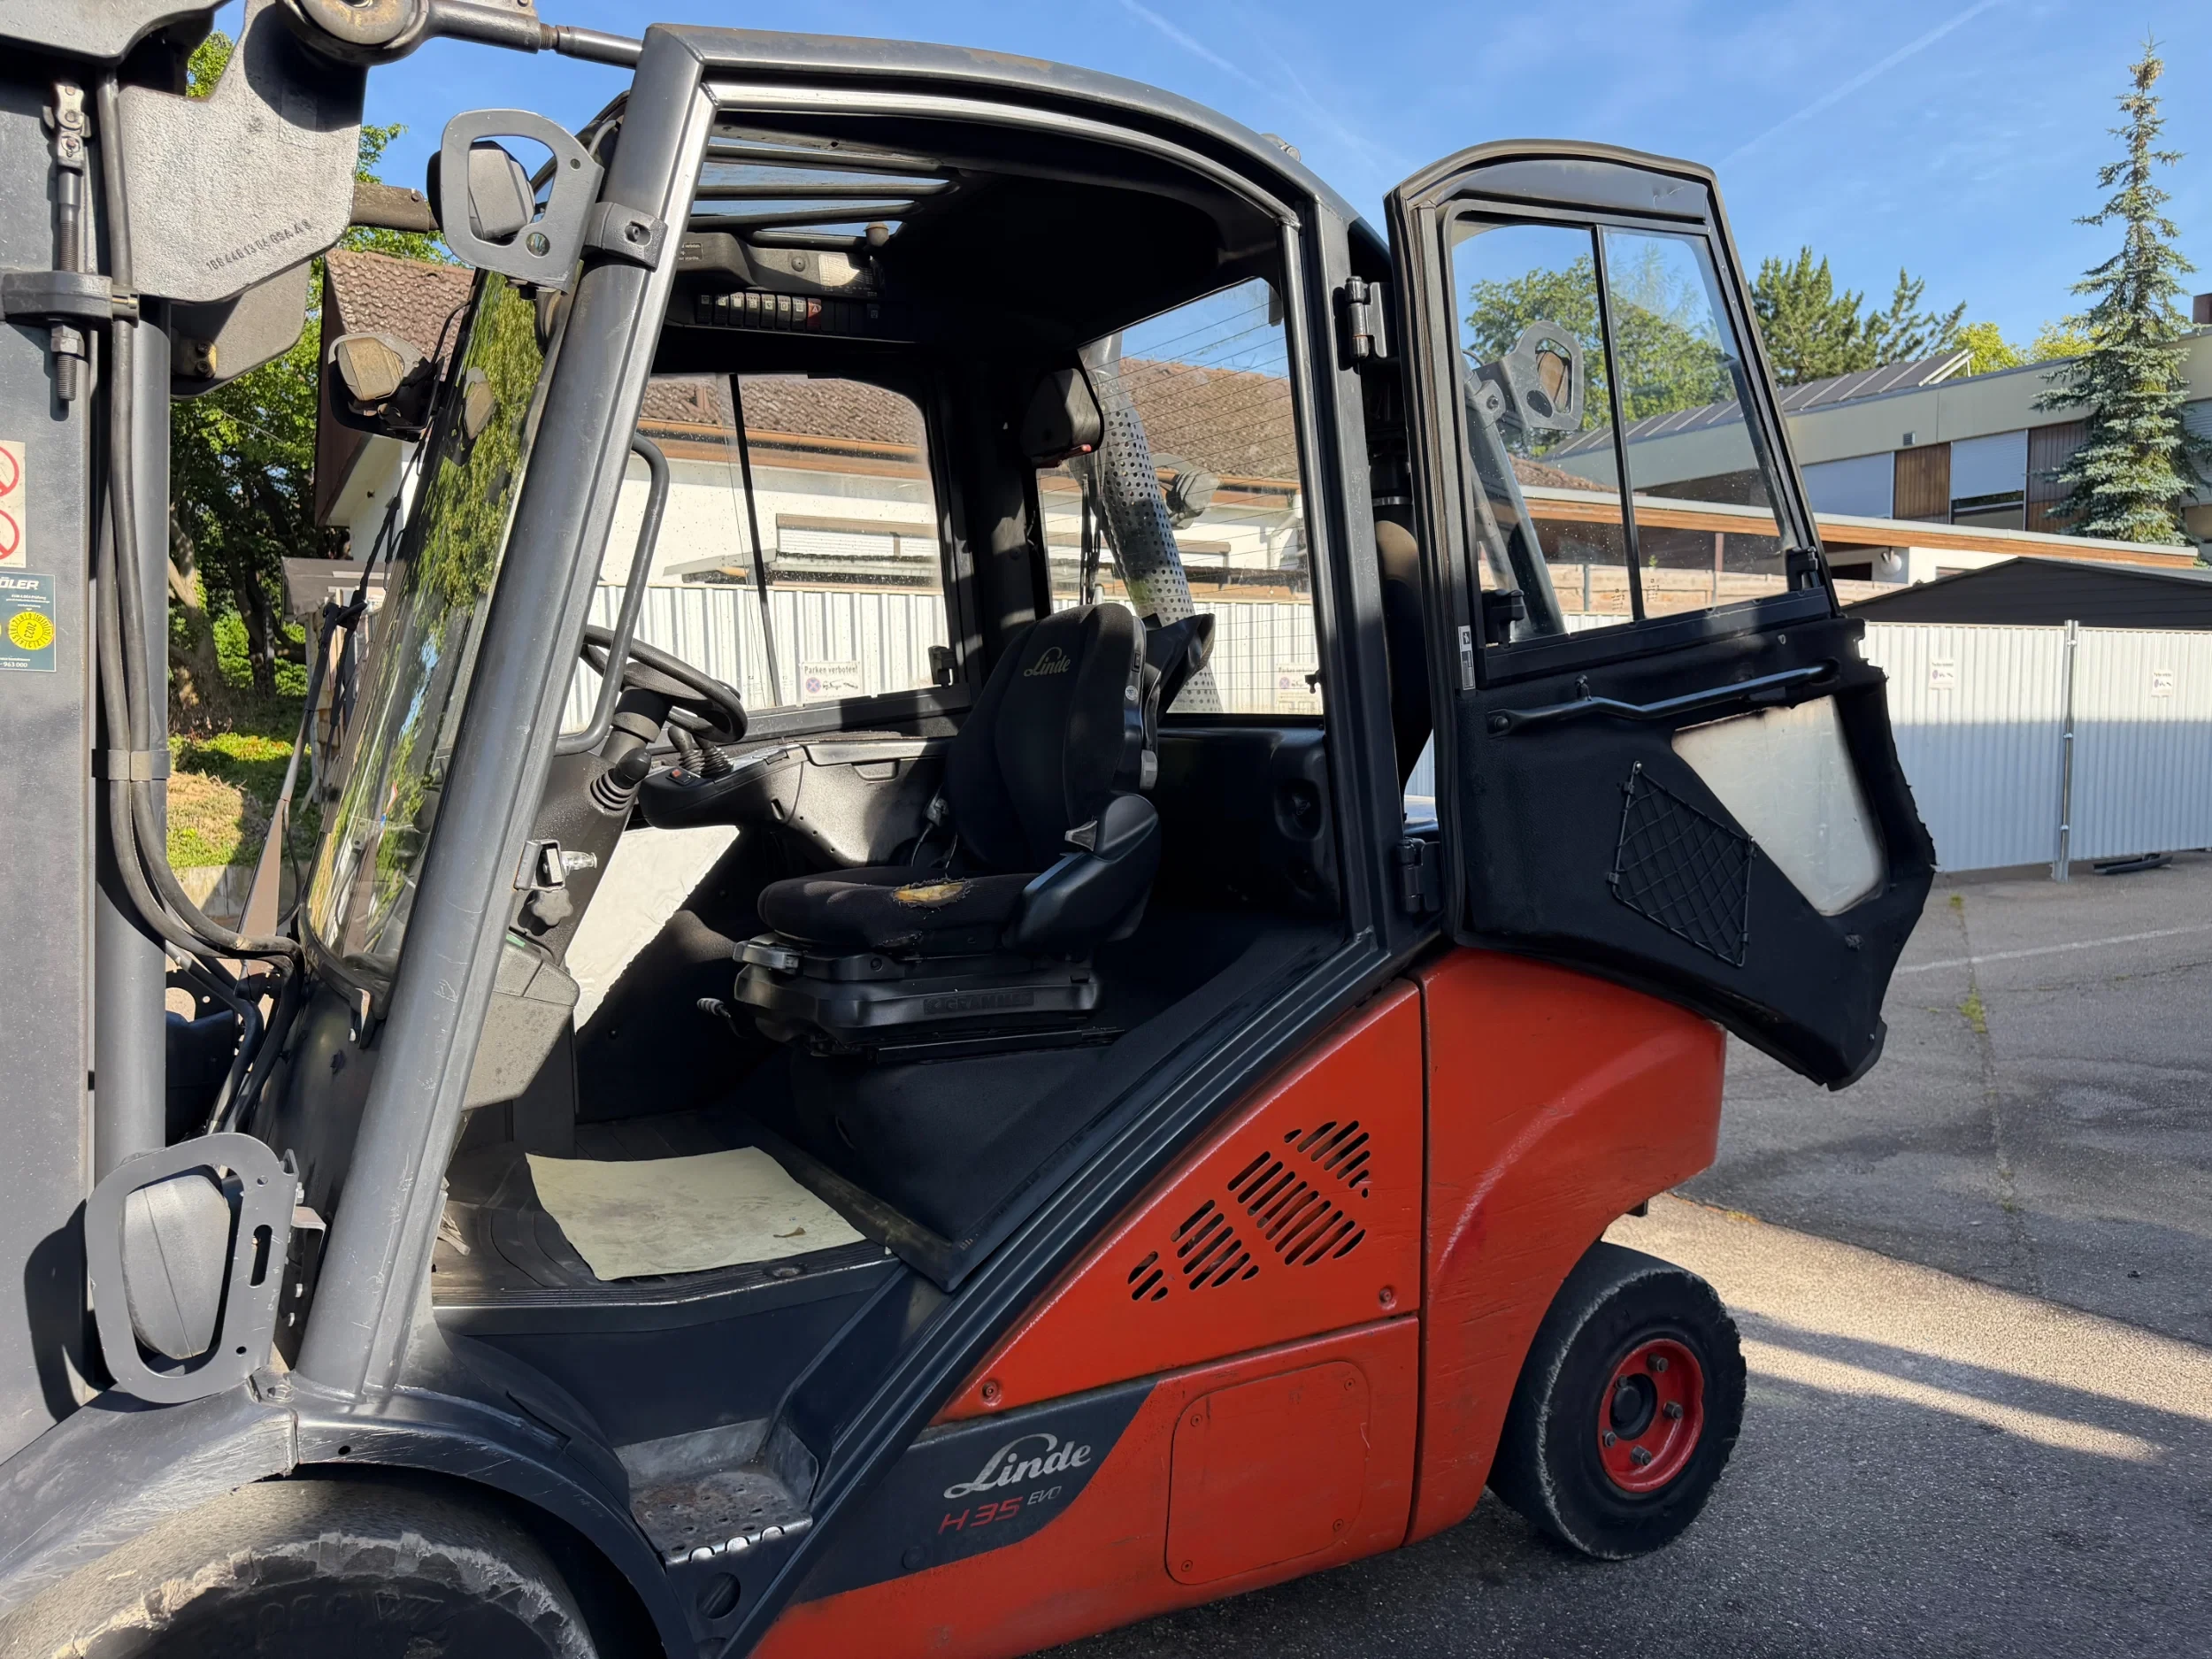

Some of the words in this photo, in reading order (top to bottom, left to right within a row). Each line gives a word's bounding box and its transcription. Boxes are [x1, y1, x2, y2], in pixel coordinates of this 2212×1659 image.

[24, 622, 36, 639] 2023
[804, 665, 827, 674] Parken
[1024, 647, 1071, 677] Linde
[943, 1432, 1092, 1499] Linde
[1026, 1485, 1063, 1505] EVO
